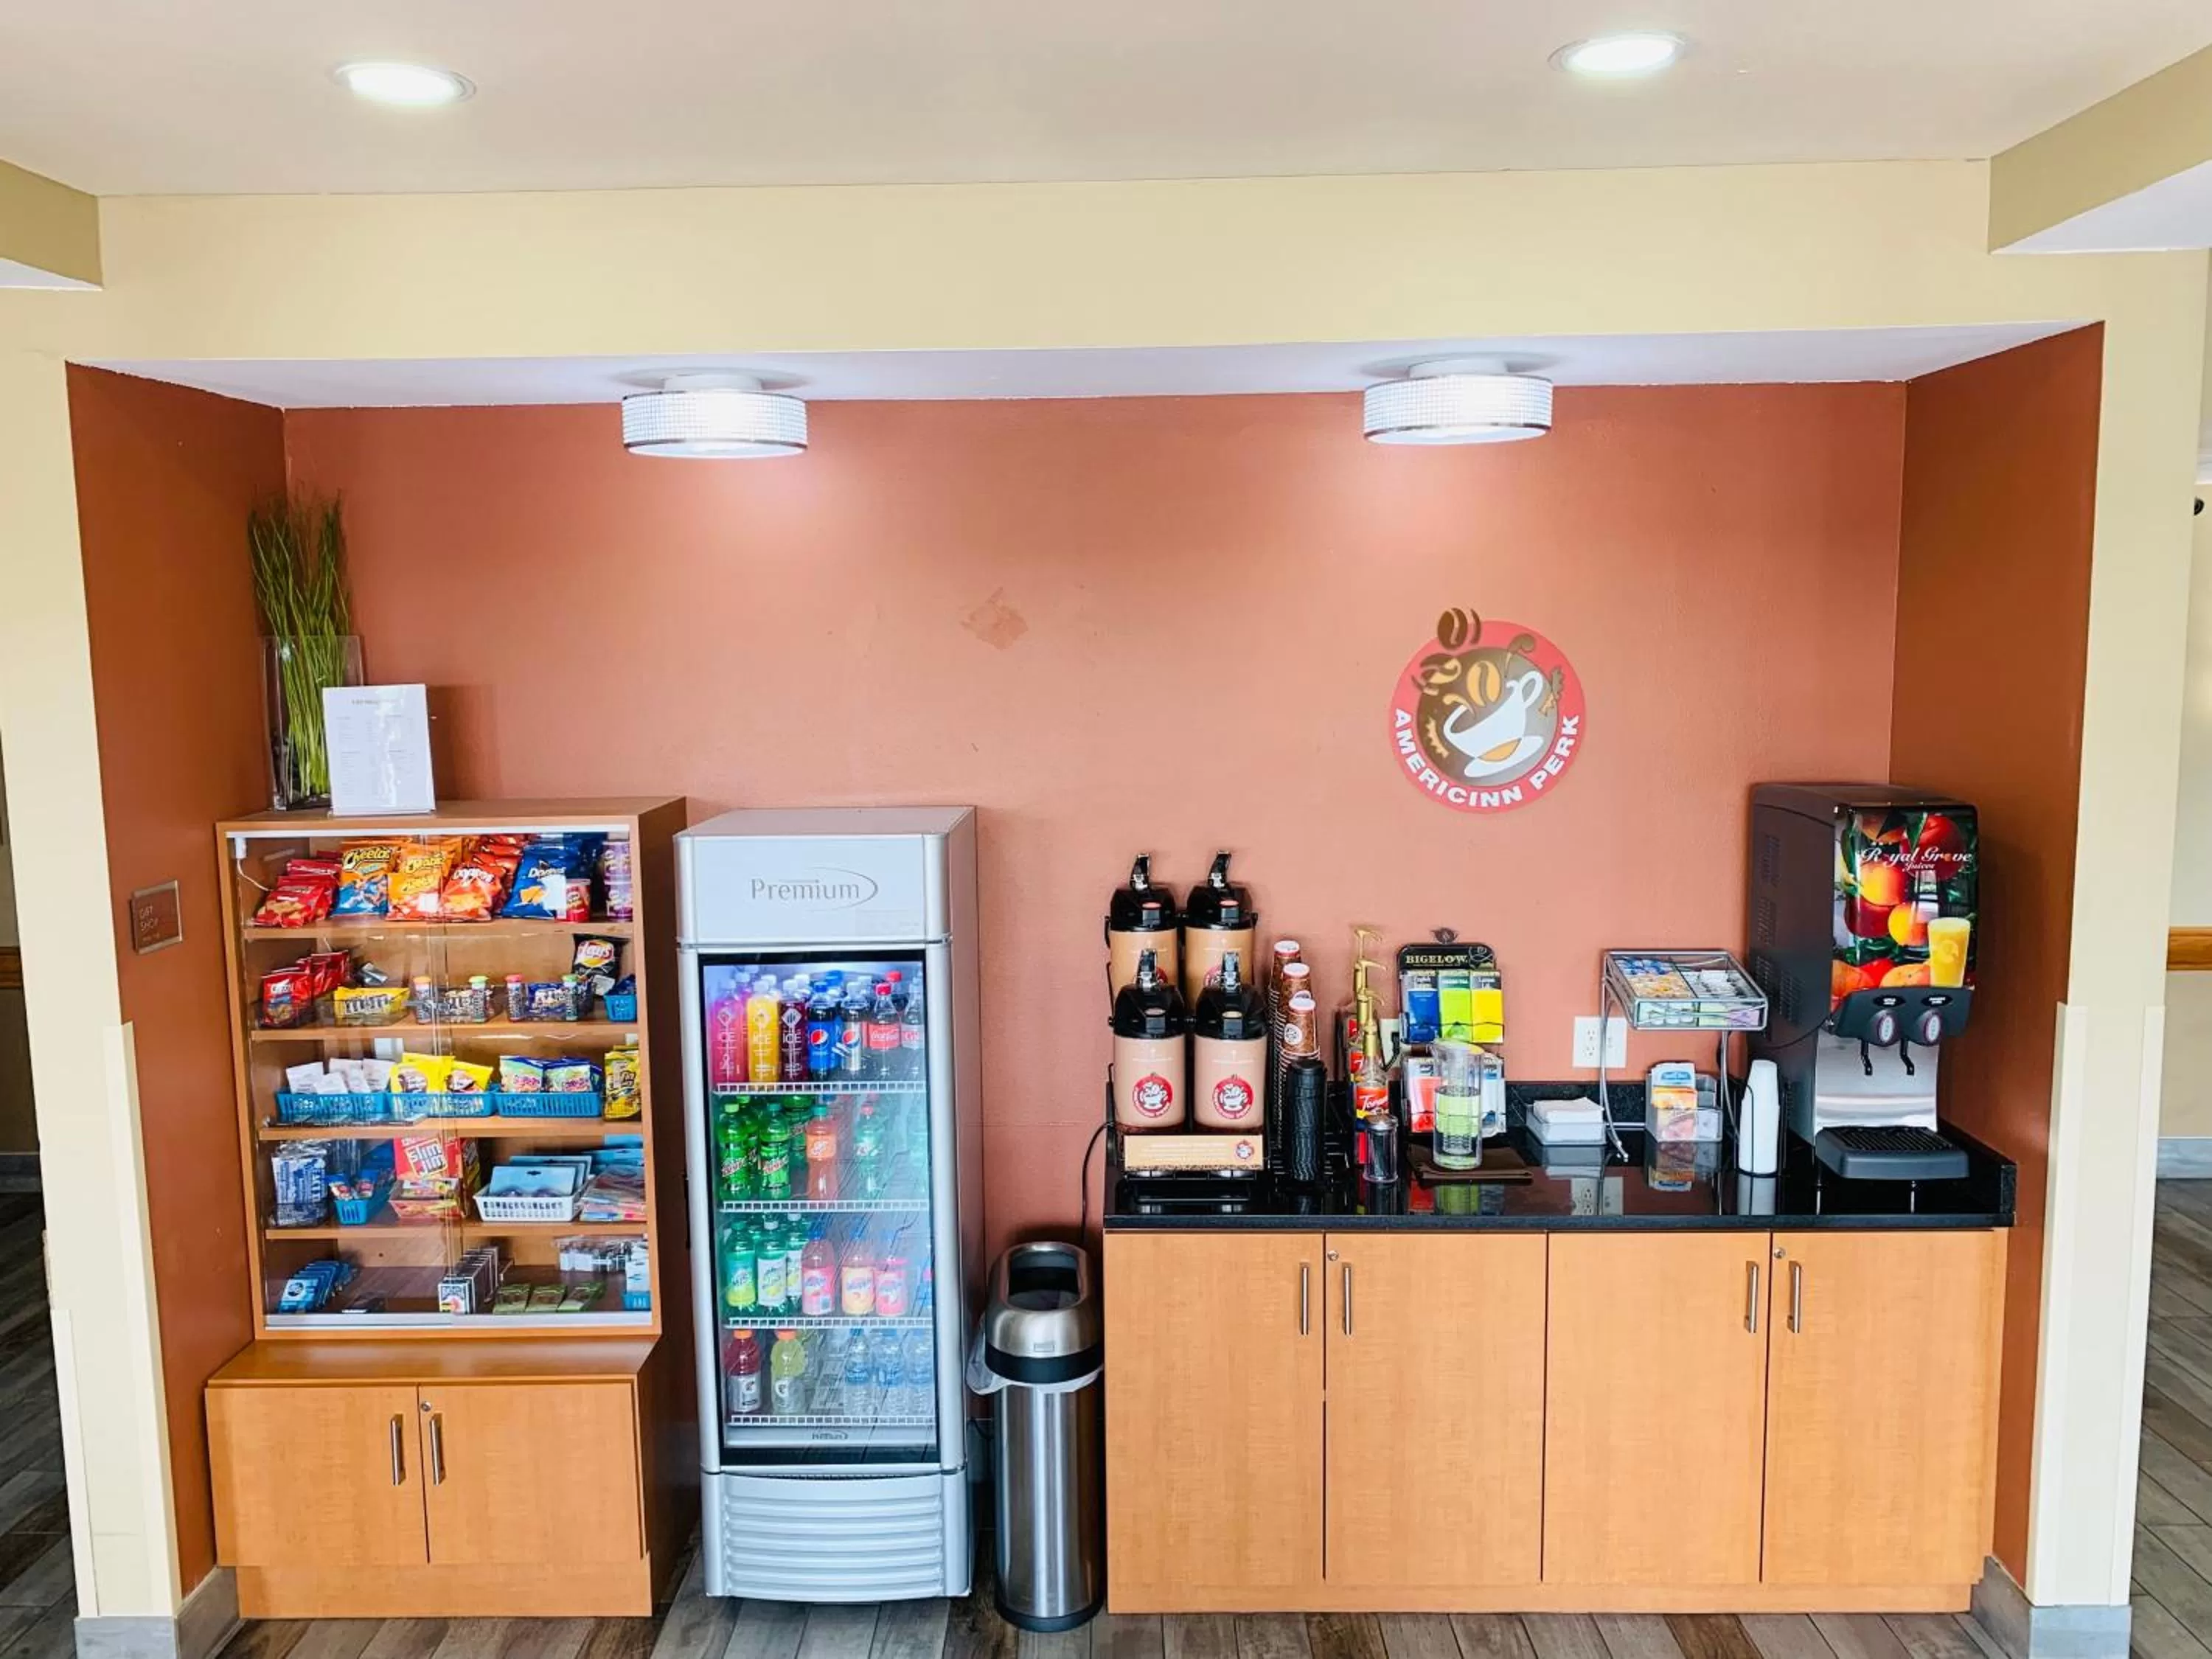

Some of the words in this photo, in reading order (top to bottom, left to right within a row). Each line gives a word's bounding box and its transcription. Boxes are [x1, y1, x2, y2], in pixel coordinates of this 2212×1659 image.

[1394, 707, 1523, 807] AMERICINN
[1529, 714, 1580, 790] PERK
[751, 878, 860, 900] Premium
[1405, 955, 1468, 964] BIGELOW
